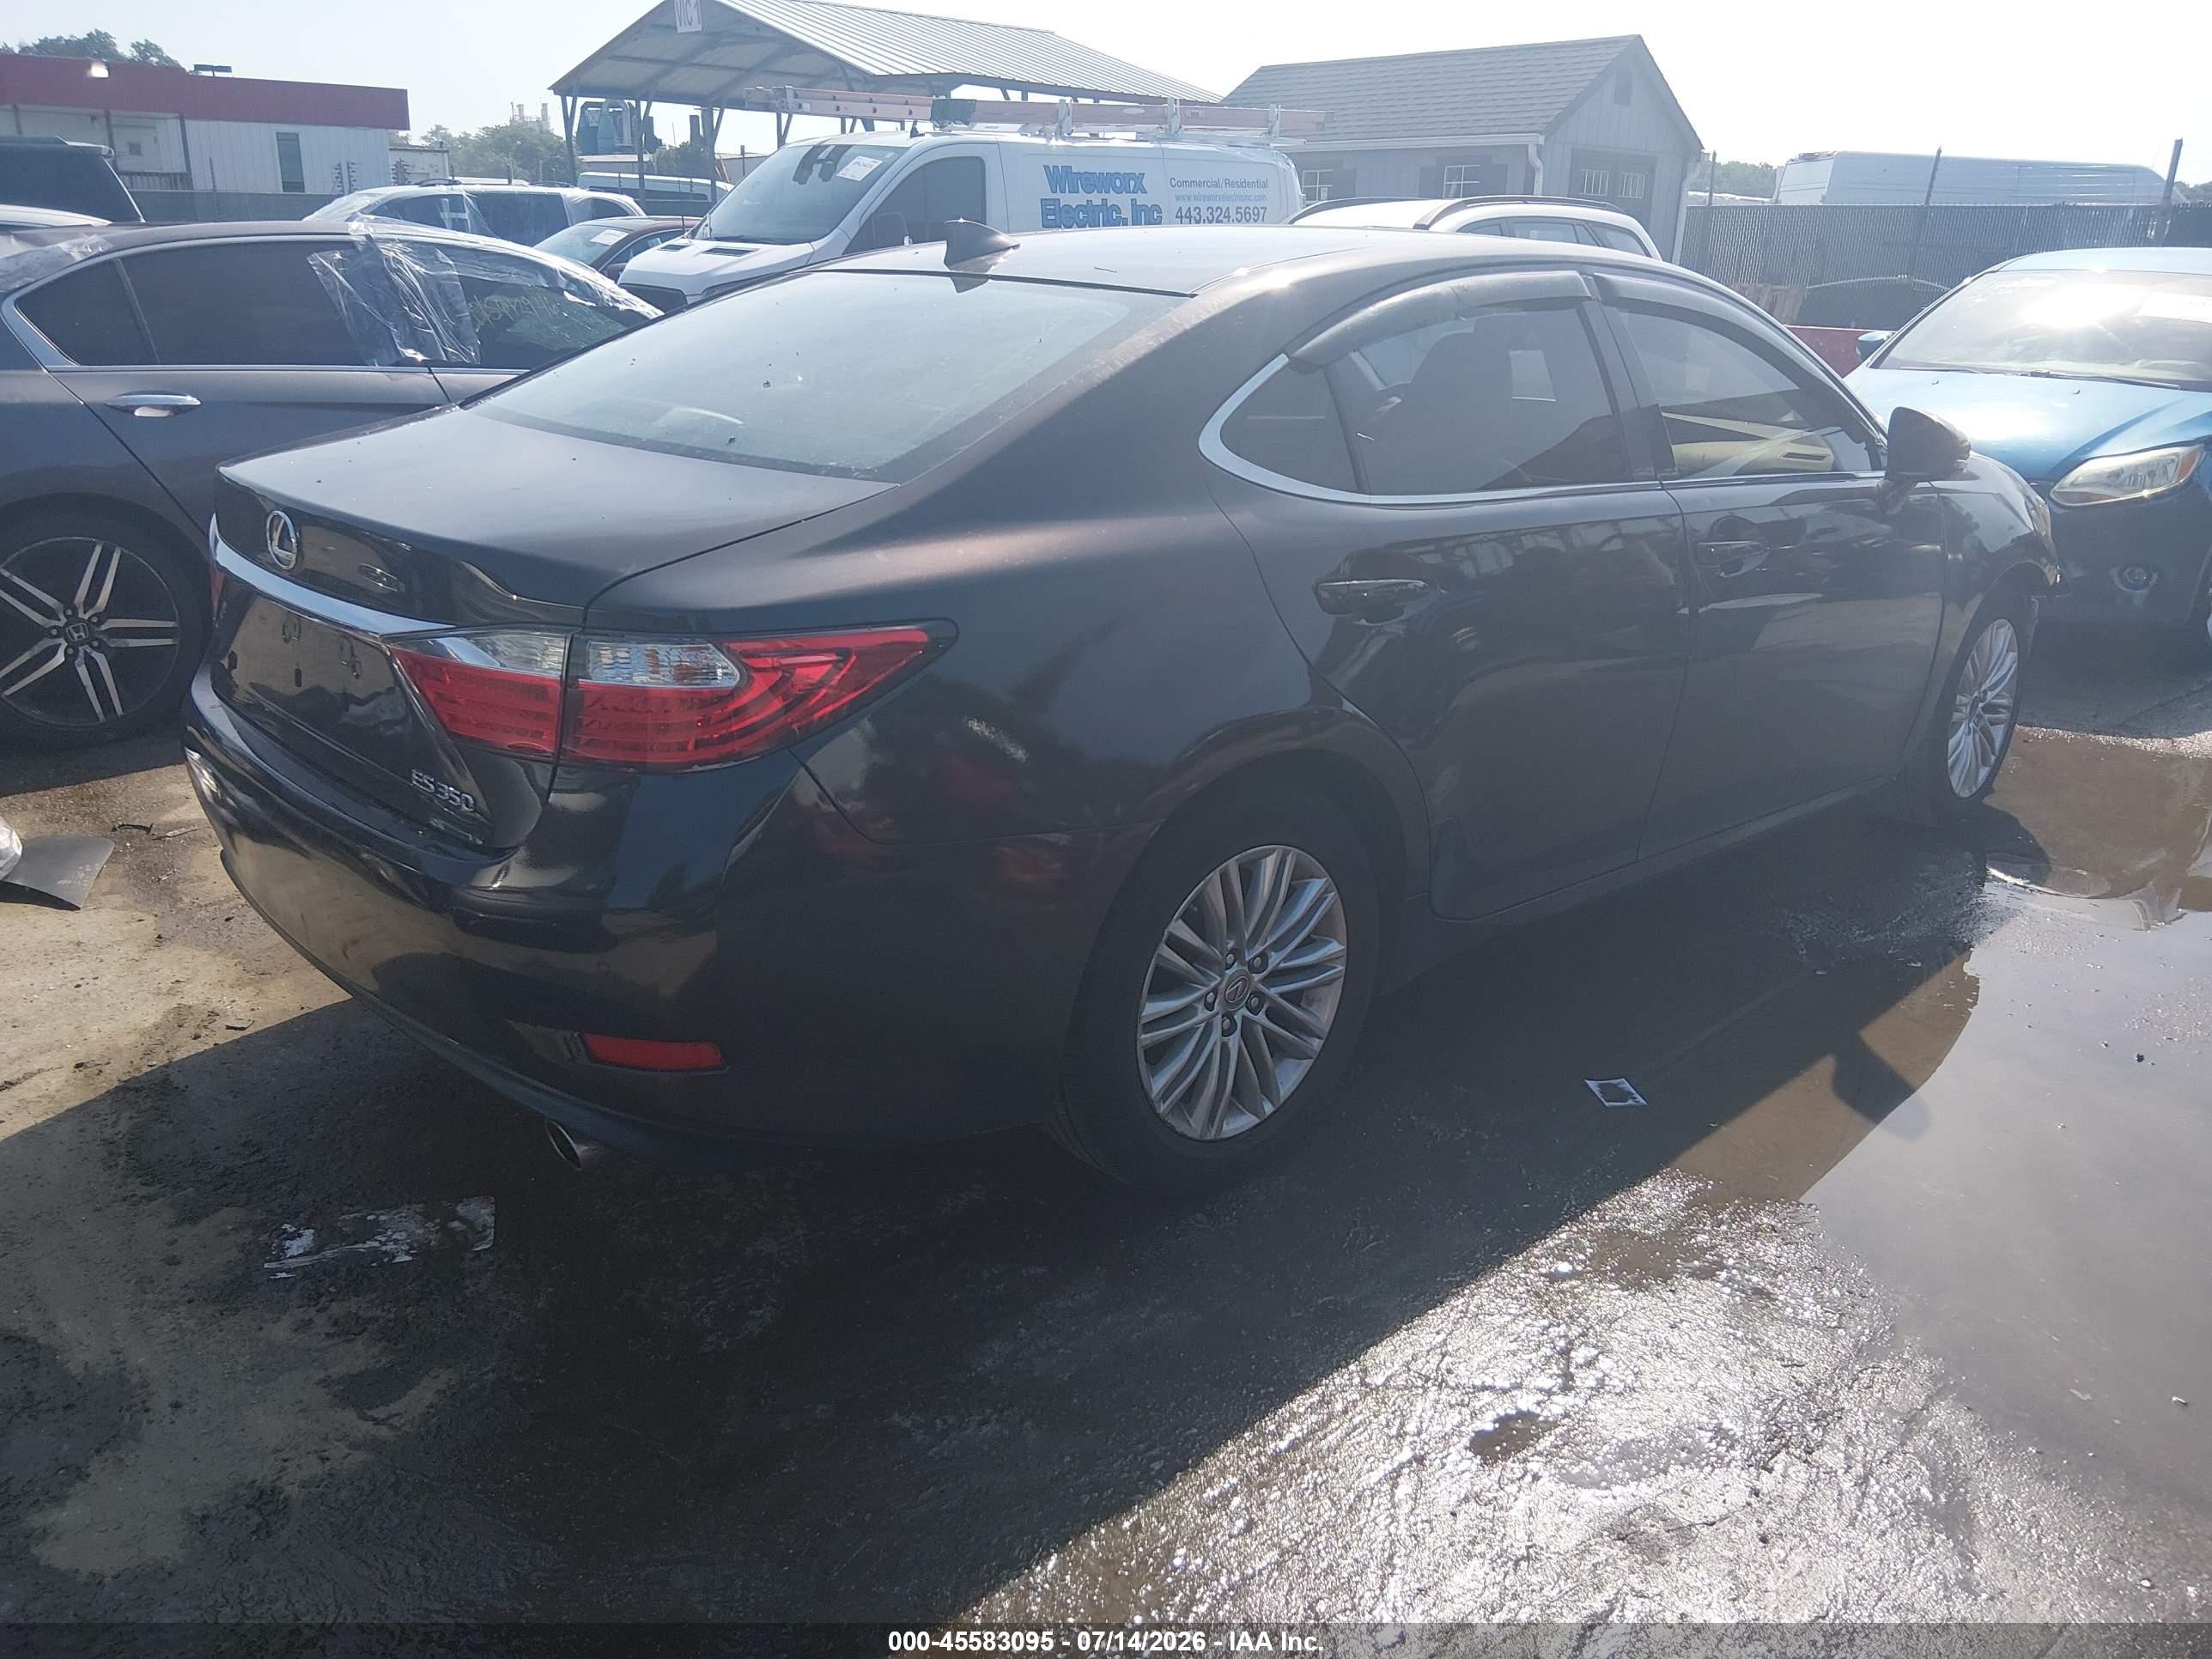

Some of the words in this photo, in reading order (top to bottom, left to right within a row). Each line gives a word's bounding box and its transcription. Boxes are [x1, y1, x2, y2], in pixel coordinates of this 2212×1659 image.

[1042, 165, 1147, 194] Wireworx
[1170, 178, 1268, 188] Commercial/Residential
[1175, 206, 1267, 224] 443.324.5697
[411, 769, 435, 793] ES
[436, 781, 475, 811] 350
